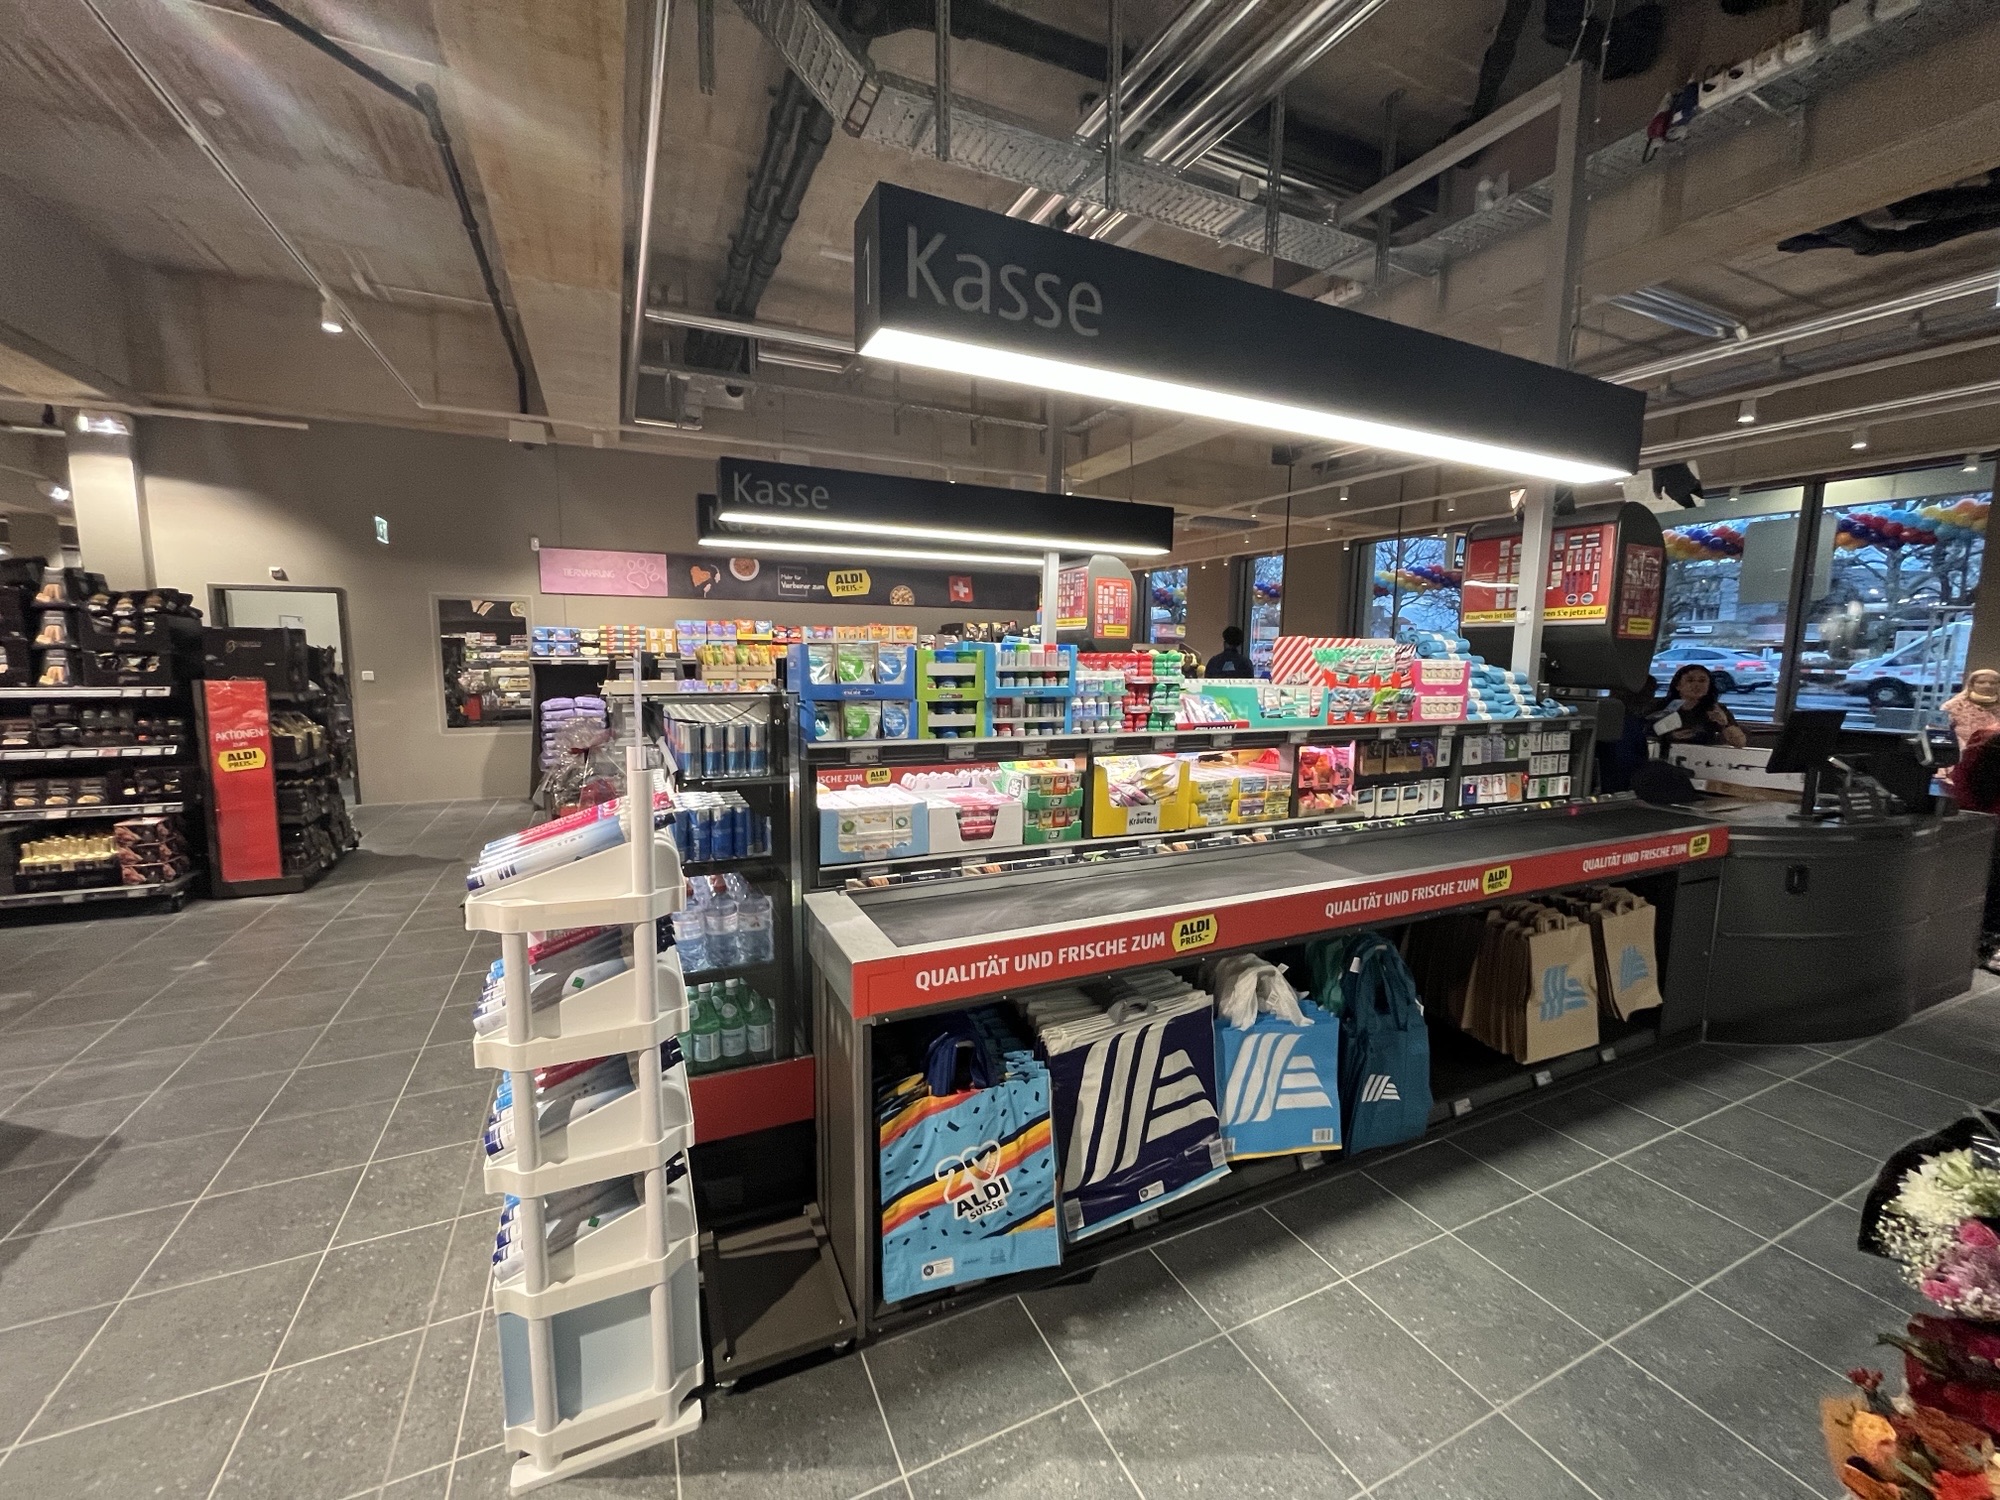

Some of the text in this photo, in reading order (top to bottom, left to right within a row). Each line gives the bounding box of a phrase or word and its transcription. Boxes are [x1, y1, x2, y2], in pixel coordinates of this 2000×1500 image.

[861, 233, 870, 305] 1
[907, 222, 1103, 337] Kasse
[733, 471, 830, 510] Kasse
[835, 572, 864, 585] ALDI
[1568, 607, 1588, 618] jetzt
[215, 728, 264, 742] AKTIONEN
[227, 750, 258, 762] ALDI
[817, 774, 863, 784] ISCHE ZUM
[870, 769, 888, 779] ALDI
[1583, 853, 1621, 872] QUALITÄT
[1622, 851, 1639, 865] UND
[1640, 845, 1670, 861] FRISCHE
[1671, 843, 1687, 856] ZUM
[1487, 869, 1508, 883] ALDI
[1325, 878, 1479, 918] QUALITÄT UND FRISCHE ZUM
[1179, 919, 1210, 938] ALDI
[915, 931, 1165, 991] QUALITÄT UND FRISCHE ZUM
[956, 1177, 1010, 1217] ALDI
[969, 1198, 1005, 1220] SUISSE
